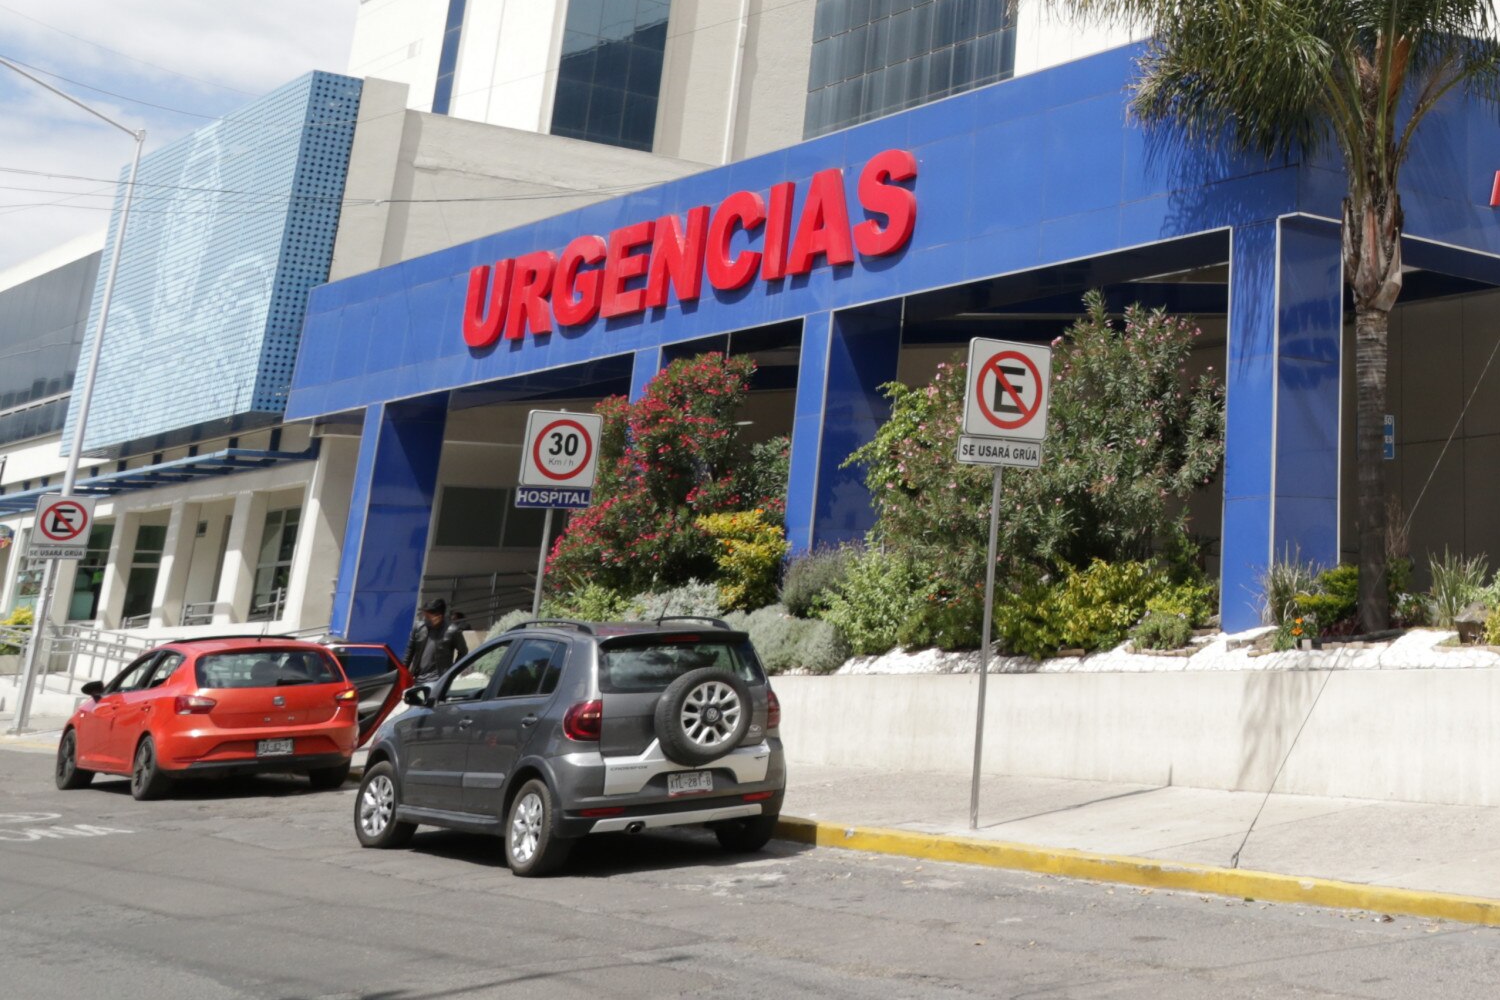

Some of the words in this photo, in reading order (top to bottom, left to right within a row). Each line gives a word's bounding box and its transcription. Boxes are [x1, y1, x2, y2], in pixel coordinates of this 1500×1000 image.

[461, 148, 918, 348] URGENCIAS
[548, 432, 579, 457] 30
[962, 444, 975, 456] SE
[978, 443, 1010, 458] USARÁ
[1012, 446, 1037, 461] GRÚA
[516, 490, 589, 504] HOSPITAL
[40, 547, 62, 557] USARÁ
